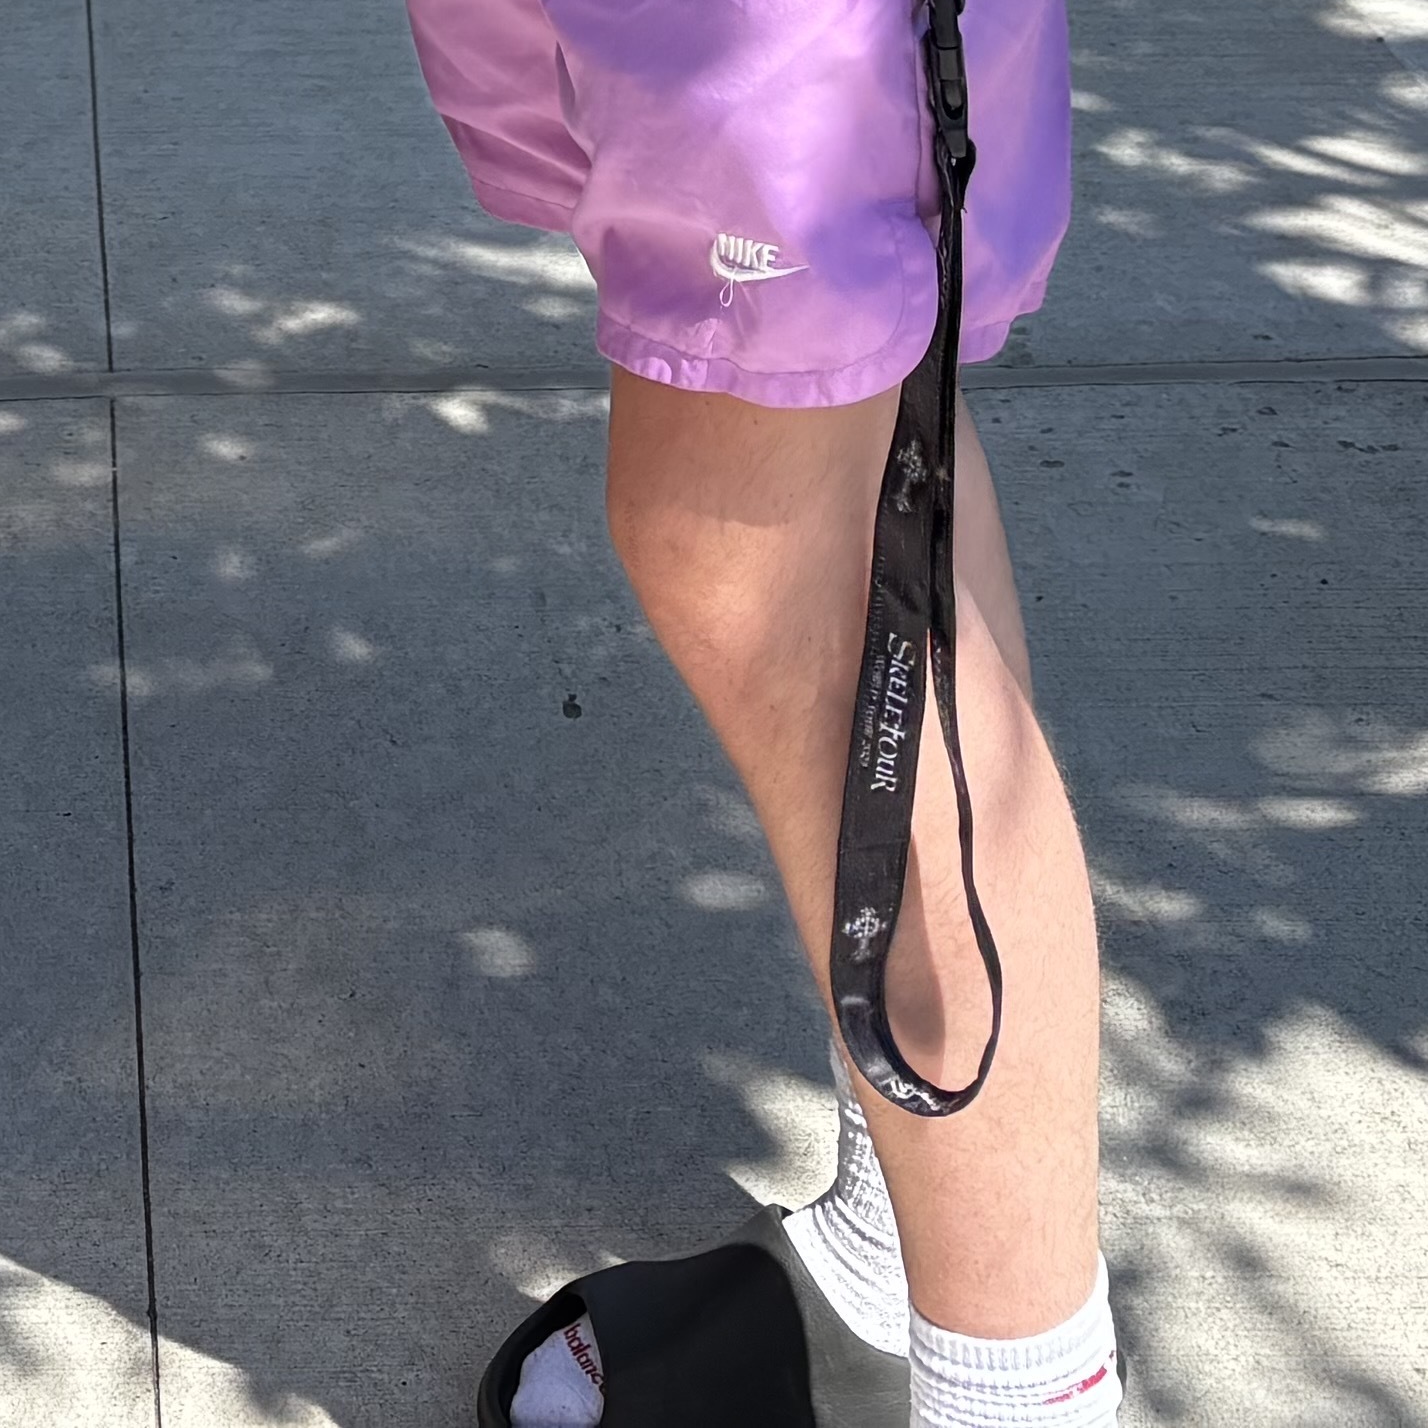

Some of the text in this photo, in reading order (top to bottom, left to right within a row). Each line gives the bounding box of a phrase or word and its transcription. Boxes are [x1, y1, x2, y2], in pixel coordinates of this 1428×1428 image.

[717, 232, 780, 270] NIKE
[871, 632, 916, 792] SKELETOUR
[563, 1322, 605, 1393] balanc
